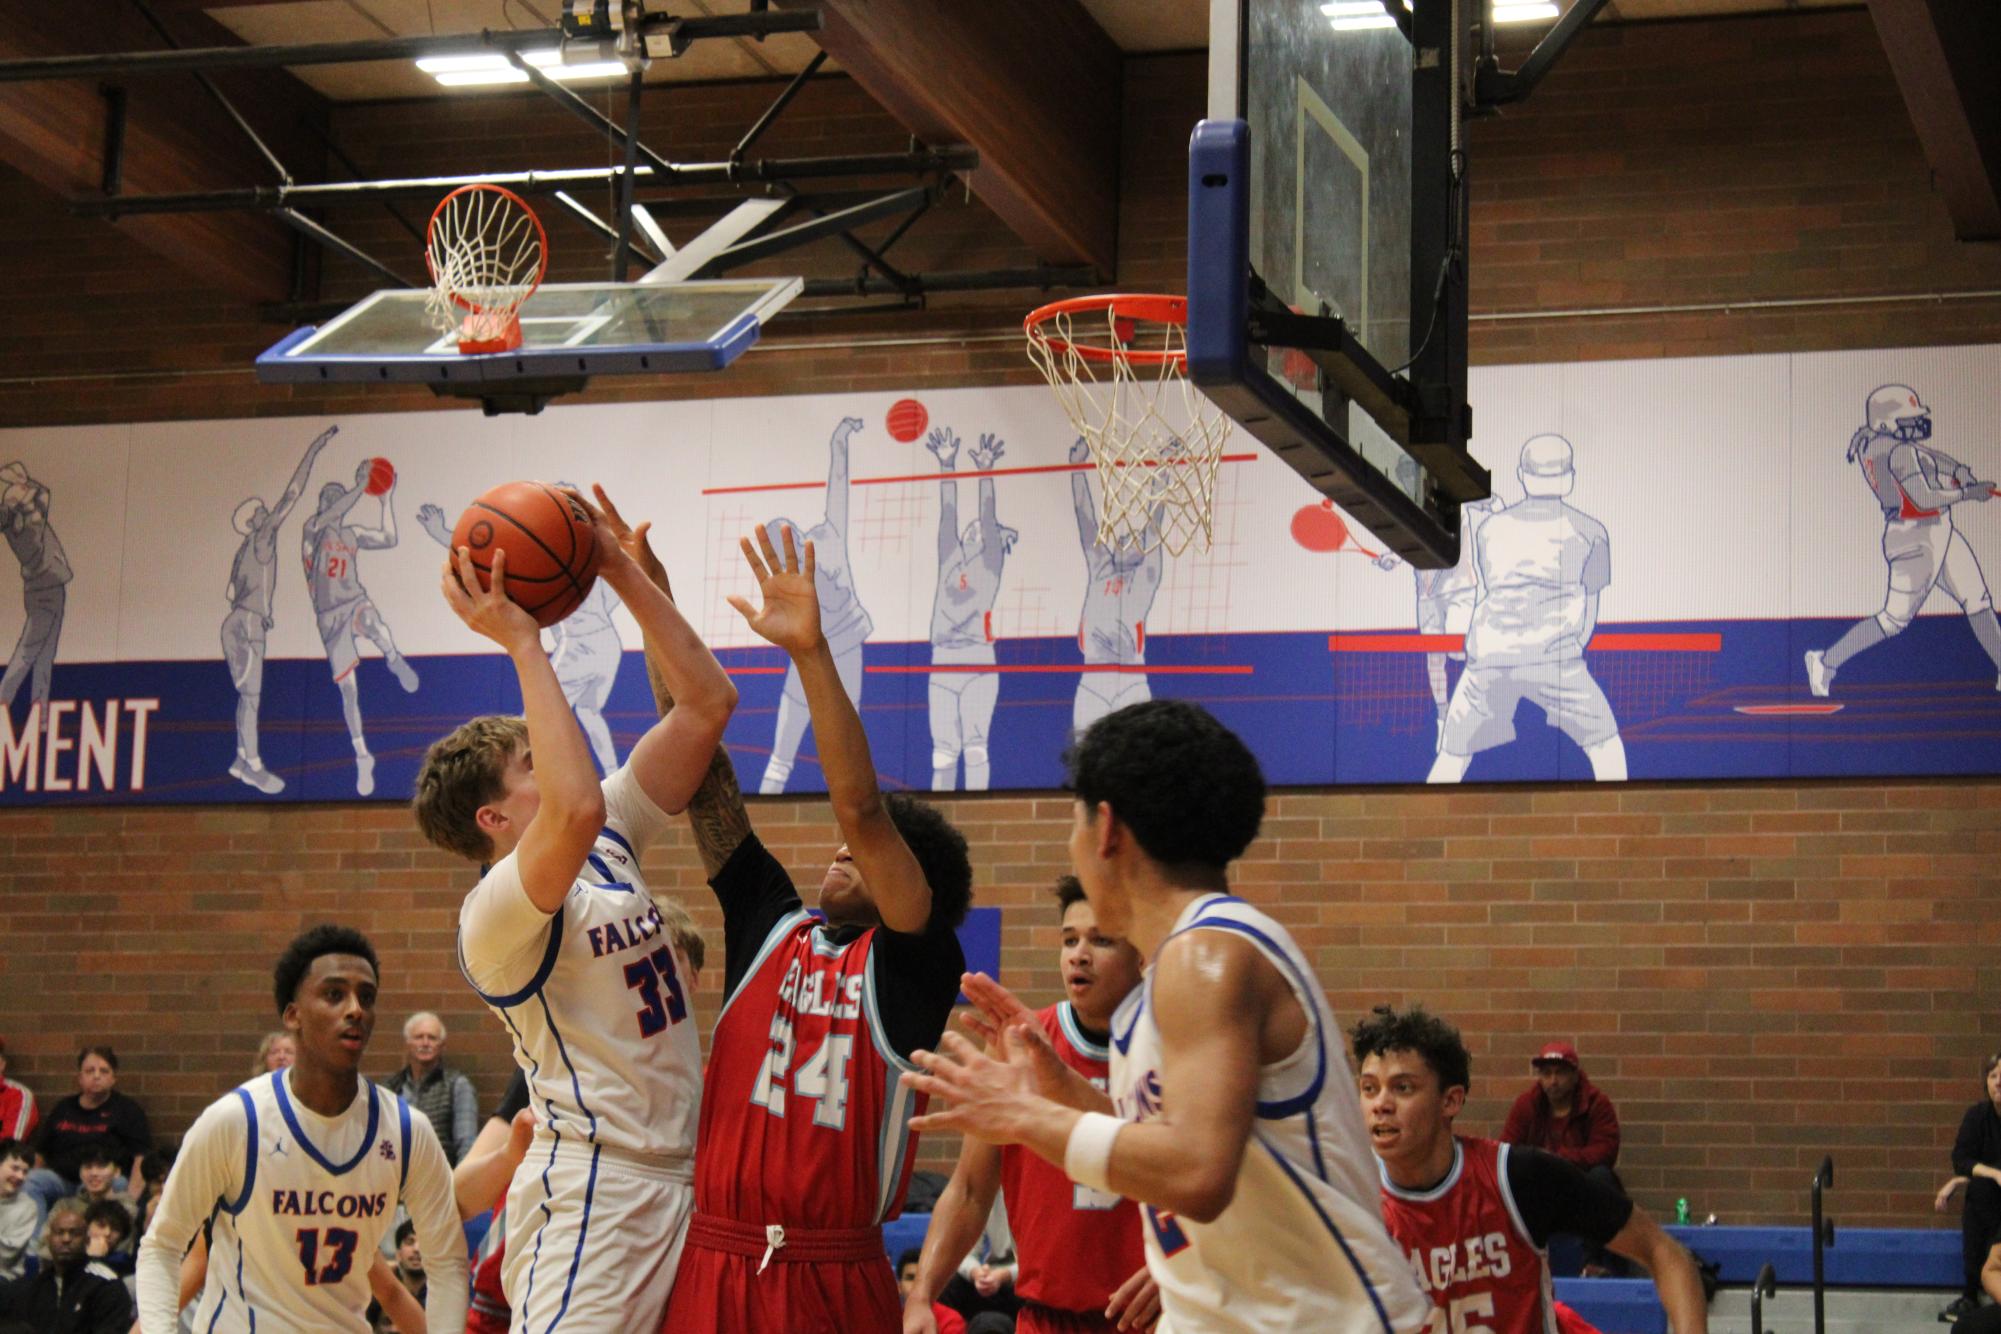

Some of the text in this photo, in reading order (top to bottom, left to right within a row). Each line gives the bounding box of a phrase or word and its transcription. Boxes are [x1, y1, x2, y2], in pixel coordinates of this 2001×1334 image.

[327, 557, 347, 578] 21
[0, 698, 160, 792] MENT
[624, 944, 687, 1039] 33
[750, 1010, 854, 1131] 24
[272, 1189, 387, 1218] FALCONS
[296, 1227, 358, 1285] 13
